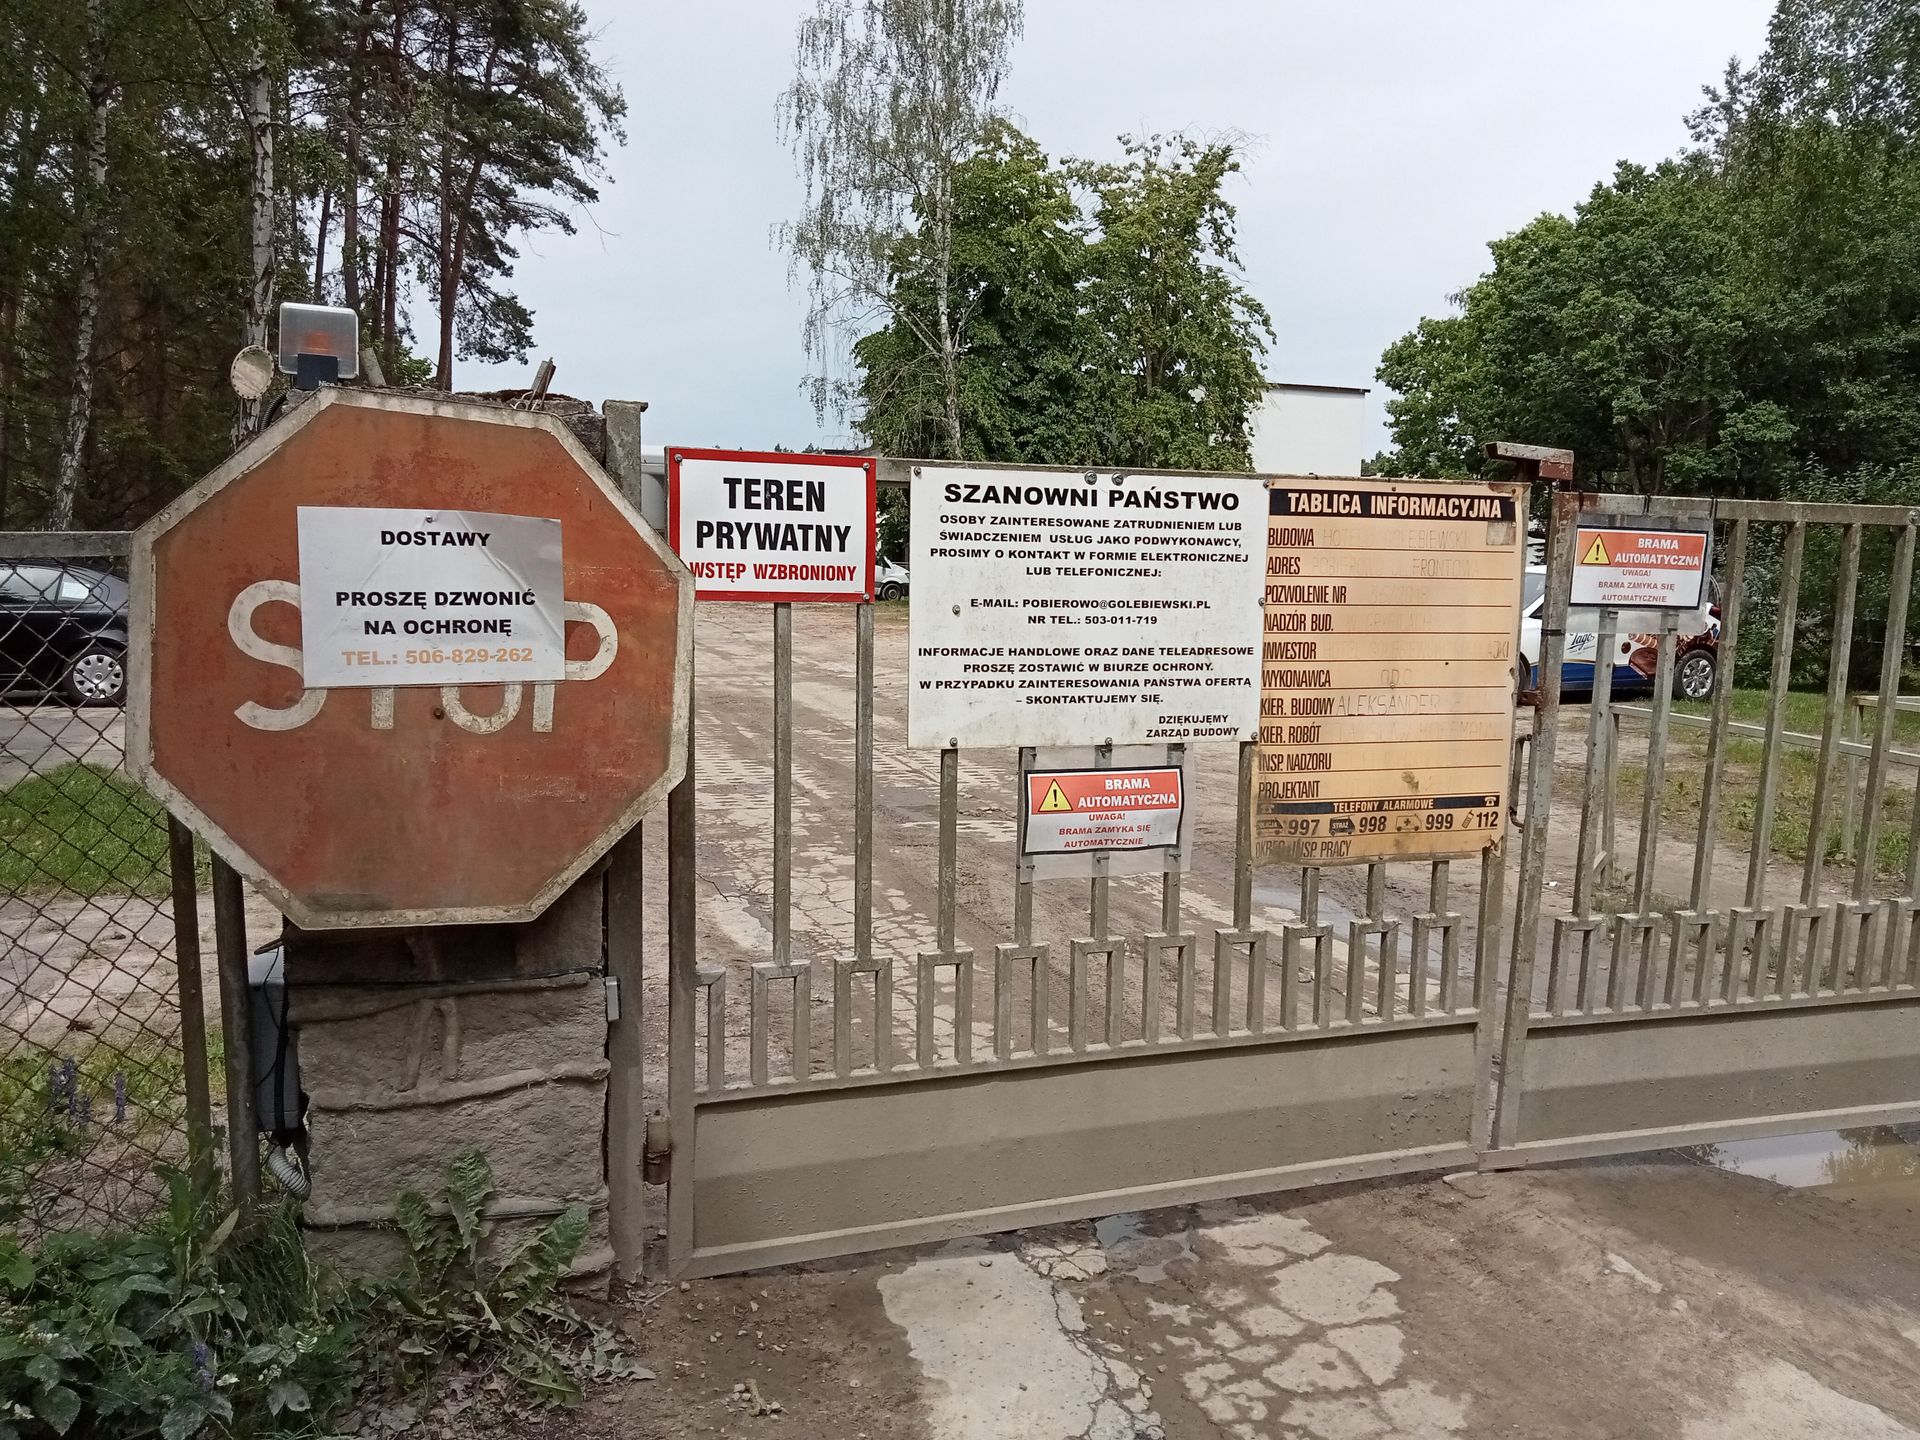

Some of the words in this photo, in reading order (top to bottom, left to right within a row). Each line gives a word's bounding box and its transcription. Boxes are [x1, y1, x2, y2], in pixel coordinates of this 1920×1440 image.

[723, 477, 825, 512] TEREN
[944, 484, 1098, 507] SZANOWNI
[1109, 487, 1239, 510] PAŃSTWO
[1288, 492, 1361, 514] TABLICA
[1371, 495, 1501, 518] INFORMACYJNA
[940, 515, 986, 525] OSOBY
[990, 516, 1109, 529] ZAINTERESOWANE
[1113, 520, 1215, 530] ZATRUDNIENIEM
[1219, 522, 1242, 531] LUB
[381, 530, 491, 547] DOSTAWY
[697, 520, 851, 552] PRYWATNY
[939, 530, 1041, 543] ŚWIADCZENIEM
[1049, 534, 1093, 544] USŁUG
[1097, 535, 1130, 545] JAKO
[1134, 536, 1241, 548] PODWYKONAWCY,
[1268, 528, 1314, 546] BUDOWA
[1638, 538, 1678, 549] BRAMA
[930, 548, 990, 558] PROSIMY
[995, 549, 1004, 559] O
[1008, 550, 1070, 560] KONTAKT
[1074, 551, 1085, 560] W
[1089, 551, 1136, 561] FORMIE
[1141, 552, 1249, 563] ELEKTRONICZNEJ
[1615, 553, 1699, 566] AUTOMATYCZNA
[690, 562, 746, 582] WSTĘP
[754, 564, 856, 581] WZBRONIONY
[1026, 567, 1051, 576] LUB
[1056, 568, 1161, 577] TELEFONICZNEJ:
[1267, 557, 1300, 575] ADRES
[1265, 584, 1329, 603] POZWOLENIE
[1332, 585, 1347, 603] NR
[1627, 582, 1658, 590] ZAMYKA
[1661, 583, 1675, 592] SIĘ
[335, 591, 427, 610] PROSZĘ
[434, 588, 536, 607] DZWONIĆ
[971, 599, 1019, 608] E-MAIL:
[1023, 599, 1210, 610] POBIEROWO@GOLEBIEWSKI.PL
[1602, 594, 1667, 602] AUTOMATYCZNIE
[364, 620, 398, 636] NA
[404, 618, 512, 636] OCHRONĘ
[1028, 616, 1045, 624] NR
[1050, 616, 1081, 624] TEL.:
[1085, 616, 1157, 625] 503-011-719
[1264, 610, 1306, 631] NADZÓR
[1311, 614, 1333, 632] BUD.
[342, 650, 398, 666] TEL.:
[406, 647, 533, 665] 506-829-262
[918, 647, 1004, 657] INFORMACJE
[1008, 647, 1080, 657] HANDLOWE
[1084, 647, 1118, 656] ORAZ
[1122, 647, 1155, 656] DANE
[1159, 647, 1254, 656] TELEADRESOWE
[1264, 642, 1316, 659] INWESTOR
[963, 663, 1014, 675] PROSZĘ
[1019, 662, 1084, 673] ZOSTAWIĆ
[1088, 664, 1099, 672] W
[1104, 663, 1149, 672] BIURZE
[1153, 662, 1213, 672] OCHRONY.
[920, 681, 932, 689] W
[936, 680, 1014, 689] PRZYPADKU
[1019, 679, 1140, 688] ZAINTERESOWANIA
[1144, 677, 1201, 687] PAŃSTWA
[1205, 677, 1251, 688] OFERTĄ
[1262, 670, 1331, 687] WYKONAWCA
[1026, 694, 1137, 705] SKONTAKTUJEMY
[1141, 694, 1163, 705] SIĘ.
[1260, 698, 1286, 716] KIER.
[1291, 698, 1334, 715] BUDOWY
[1146, 728, 1189, 739] ZARZĄD
[1193, 727, 1239, 736] BUDOWY
[1260, 725, 1286, 743] KIER.
[1288, 723, 1321, 743] ROBÓT
[1259, 753, 1284, 771] INSP.
[1287, 752, 1331, 770] NADZORU
[1105, 778, 1150, 790] BRAMA
[1259, 781, 1320, 799] PROJEKTANT
[1078, 794, 1176, 808] AUTOMATYCZNA
[1333, 802, 1378, 813] TELEFONY
[1383, 799, 1434, 810] ALARMOWE
[1089, 813, 1125, 821] UWAGA!
[1359, 816, 1386, 832] 998
[1426, 814, 1454, 830] 999
[1477, 811, 1498, 827] 112
[1059, 827, 1092, 835] BRAMA
[1288, 819, 1320, 835] 997
[1064, 838, 1143, 848] AUTOMATYCZNIE
[1320, 839, 1352, 858] PRACY
